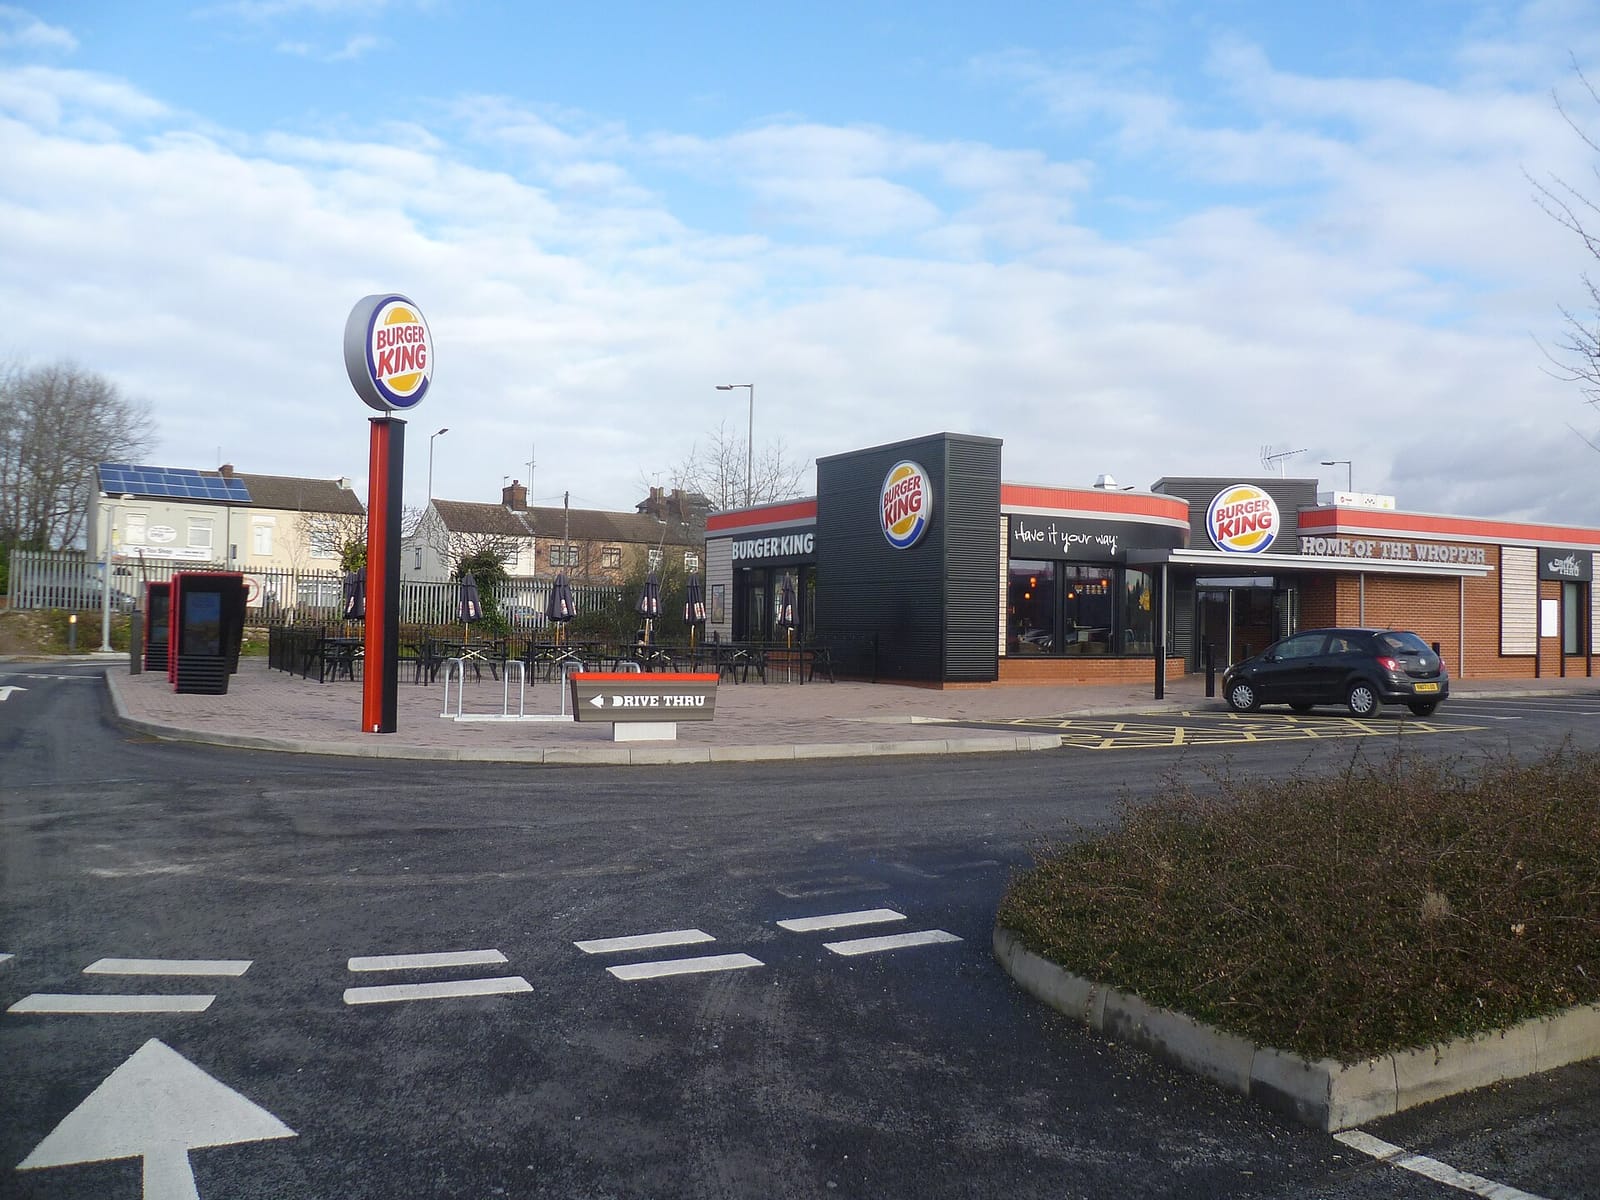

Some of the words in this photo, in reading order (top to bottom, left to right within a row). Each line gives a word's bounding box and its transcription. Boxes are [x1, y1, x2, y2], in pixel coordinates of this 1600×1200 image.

[377, 326, 425, 350] BURGER
[377, 344, 427, 378] KING
[884, 475, 921, 509] BURGER
[884, 490, 922, 531] KING
[1216, 500, 1270, 523] BURGER
[1014, 521, 1045, 543] Have
[1047, 523, 1058, 545] it
[1061, 532, 1093, 554] your
[1218, 512, 1272, 541] KING
[732, 537, 778, 560] BURGER
[780, 533, 814, 556] KING
[1301, 537, 1350, 555] HOME
[1354, 540, 1376, 557] OF
[1380, 541, 1412, 560] THE
[1414, 543, 1486, 563] WHOPPER
[612, 695, 659, 707] DRIVE
[663, 695, 706, 707] THRU
